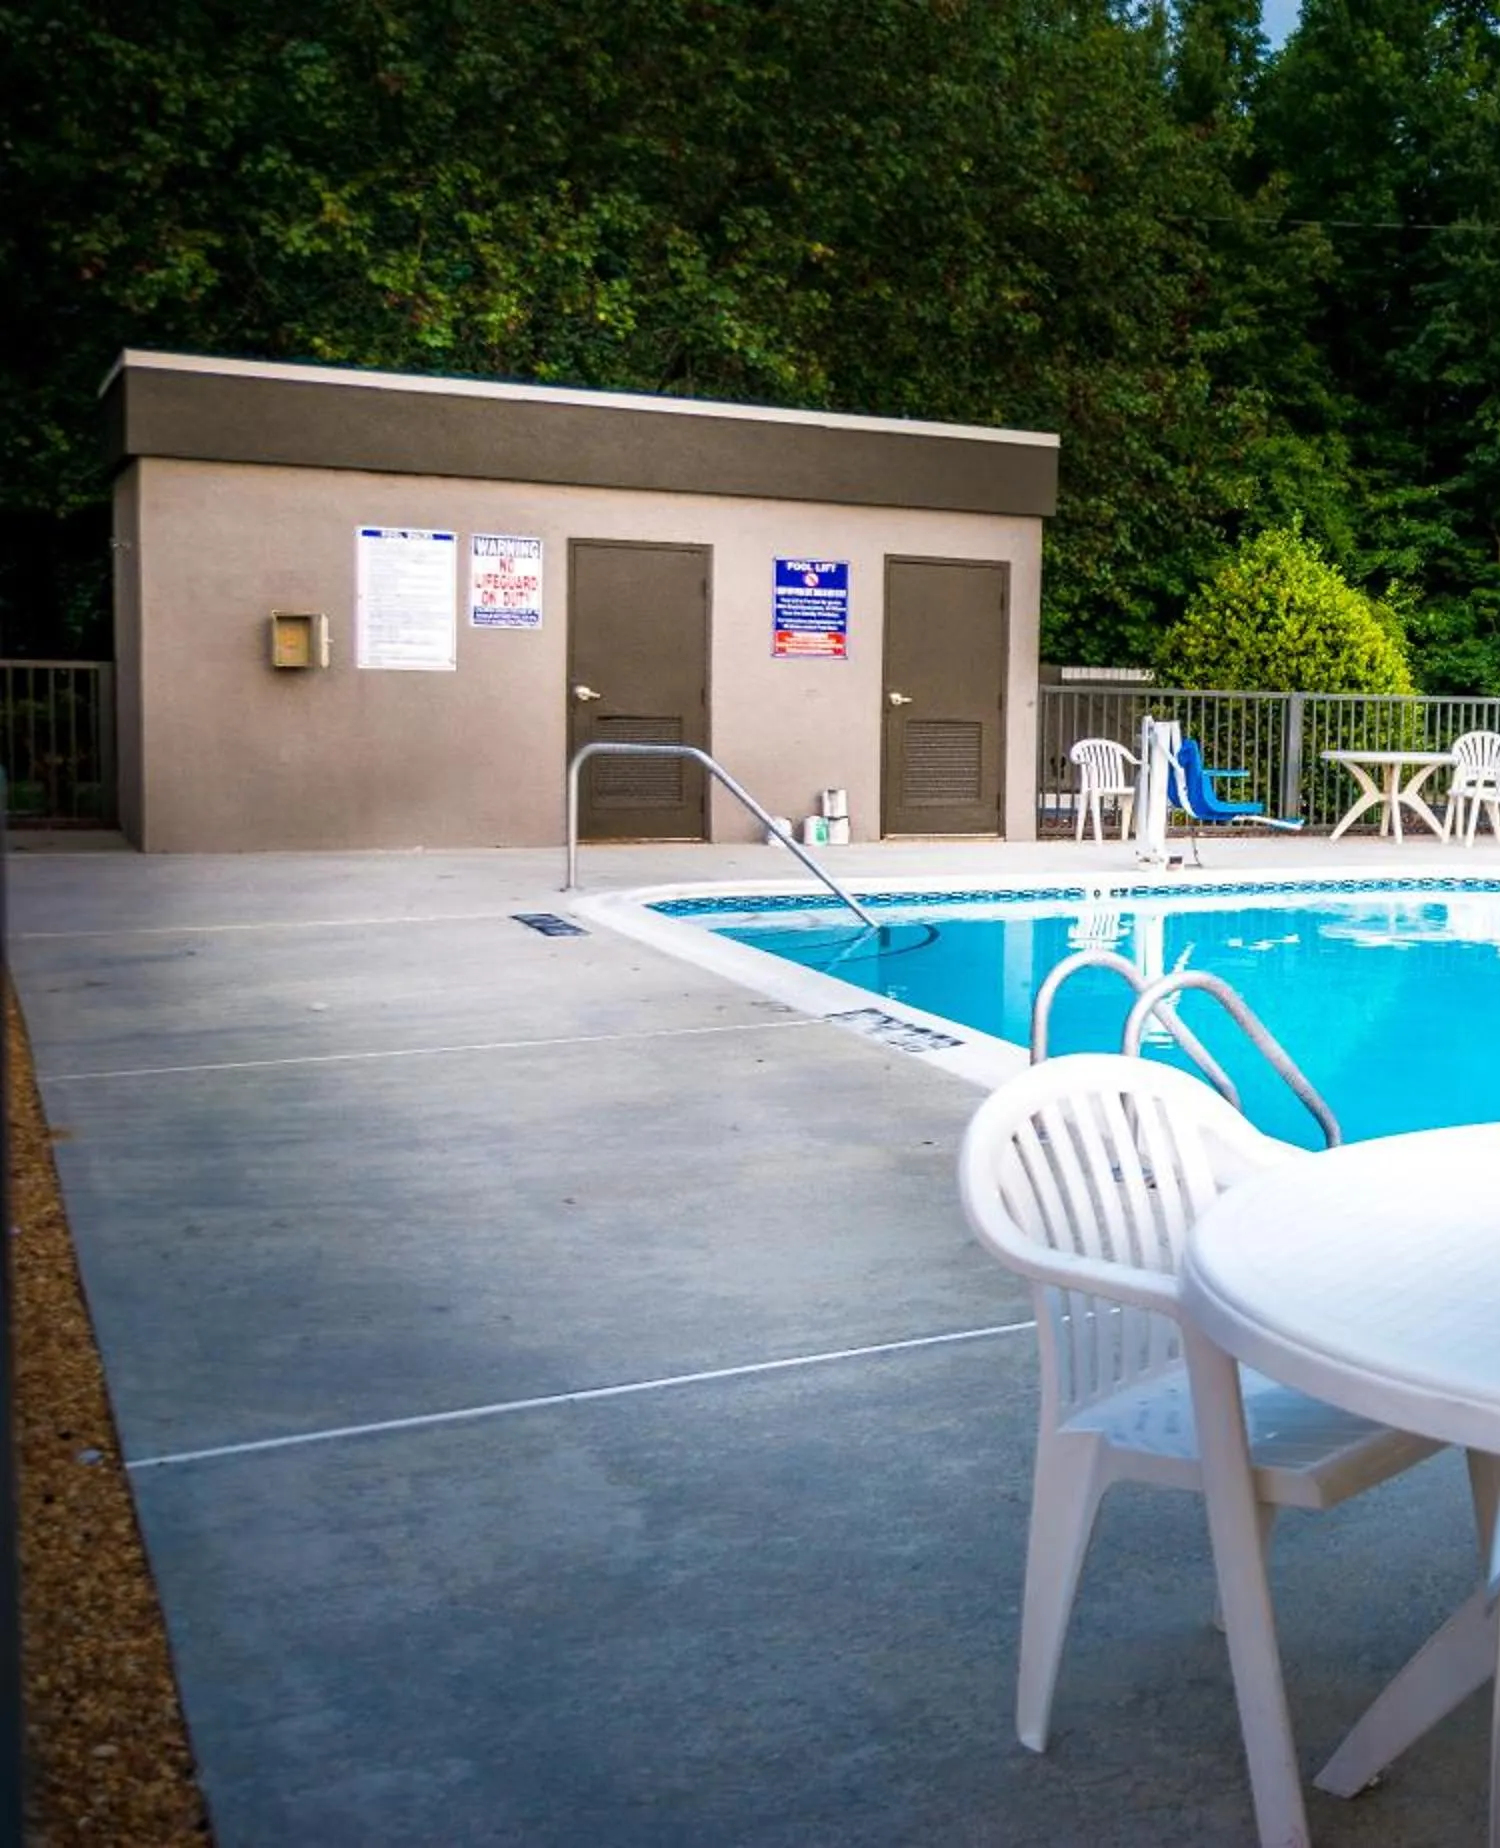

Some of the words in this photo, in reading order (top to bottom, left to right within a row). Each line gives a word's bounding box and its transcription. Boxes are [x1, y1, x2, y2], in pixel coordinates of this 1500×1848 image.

[477, 537, 539, 558] WARNING
[500, 558, 514, 573] NO
[787, 562, 813, 572] POOL
[815, 563, 837, 573] LIFT
[475, 573, 538, 591] LIFEGUARD
[482, 590, 496, 606] ON
[503, 591, 531, 606] DUTY
